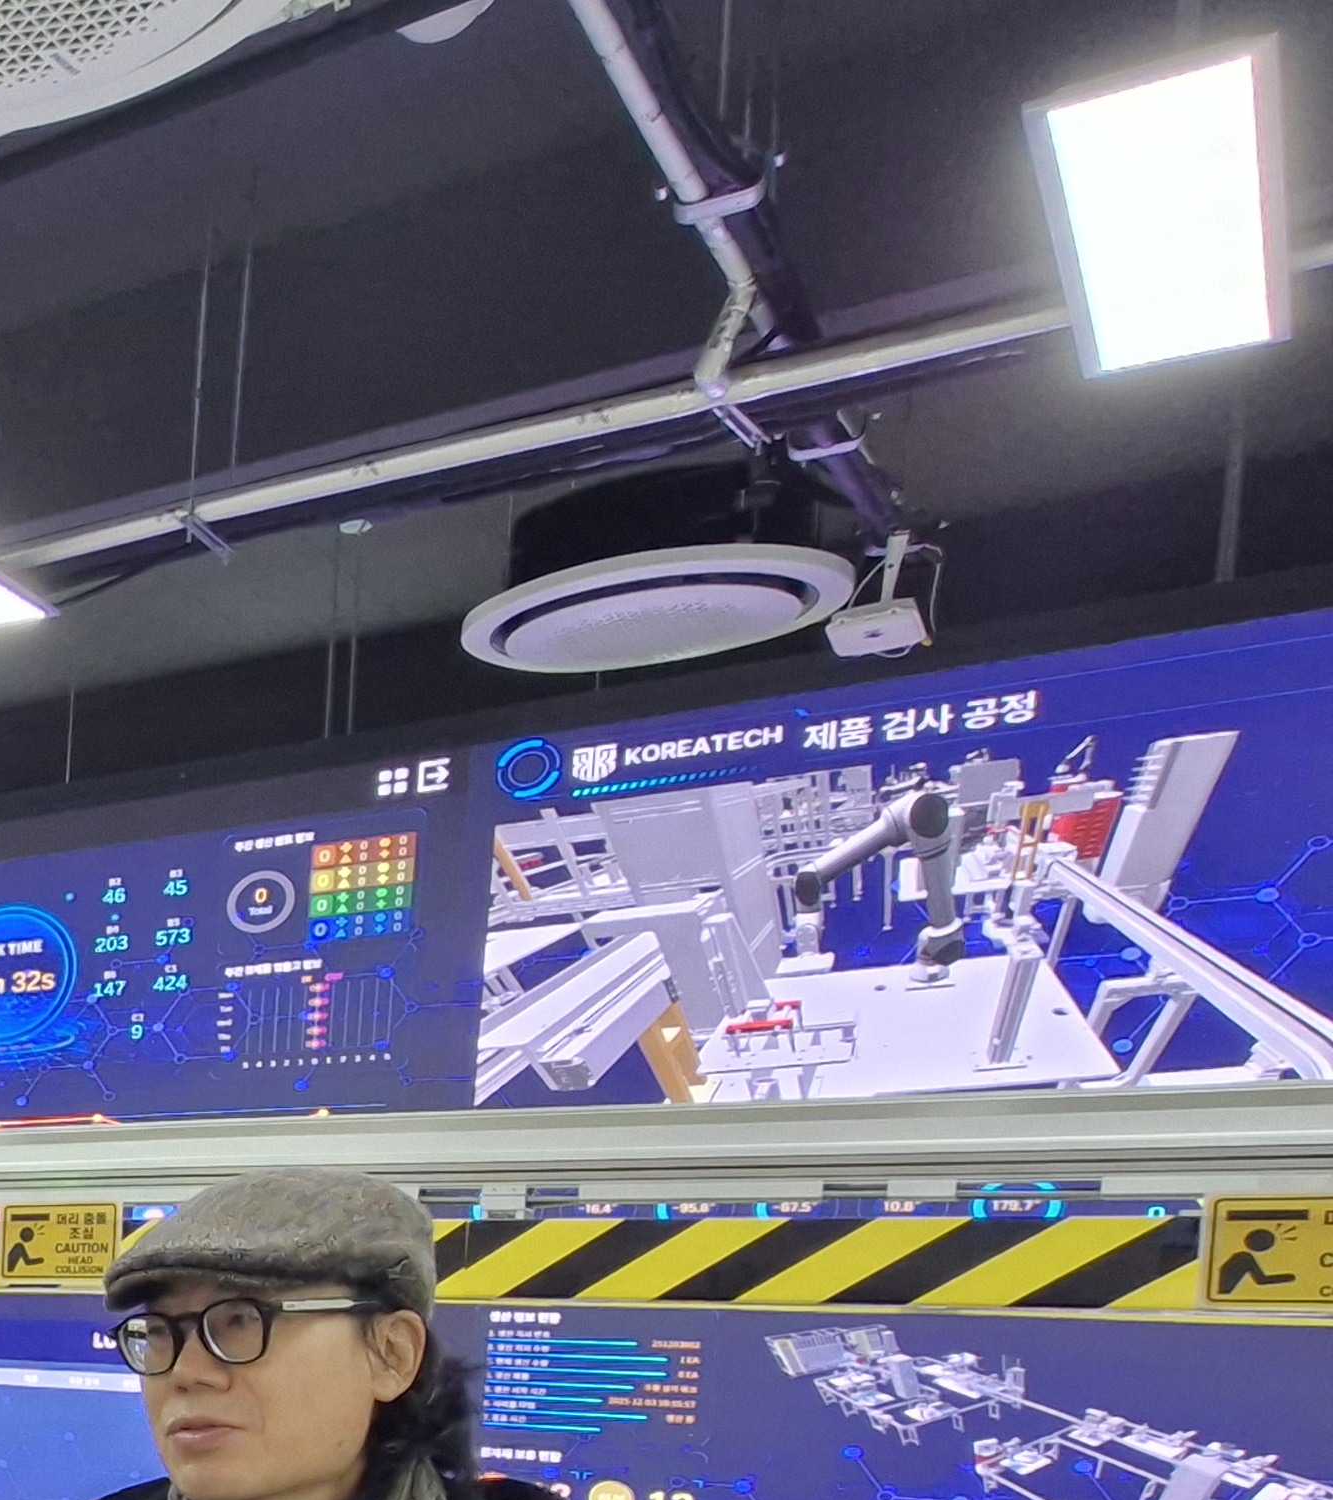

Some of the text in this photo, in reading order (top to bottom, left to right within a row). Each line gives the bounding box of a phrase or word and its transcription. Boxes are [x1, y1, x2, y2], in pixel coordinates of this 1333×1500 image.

[624, 690, 1038, 767] KOREATECH 제품 검사 공정
[319, 849, 331, 862] 0
[163, 879, 188, 896] 45
[317, 874, 329, 887] 0
[101, 887, 127, 904] 46
[254, 887, 268, 903] 0
[316, 899, 328, 912] 0
[155, 928, 191, 946] 573
[314, 923, 326, 937] 0
[7, 938, 44, 955] TIME
[94, 935, 129, 953] 203
[11, 970, 56, 993] 32s
[93, 980, 127, 997] 147
[152, 974, 188, 992] 424
[131, 1024, 143, 1040] 9
[56, 1212, 106, 1225] 머리 충돌
[69, 1227, 94, 1239] 조심
[55, 1242, 109, 1254] CAUTION
[68, 1256, 93, 1264] HEAD
[55, 1265, 104, 1274] COLLISION
